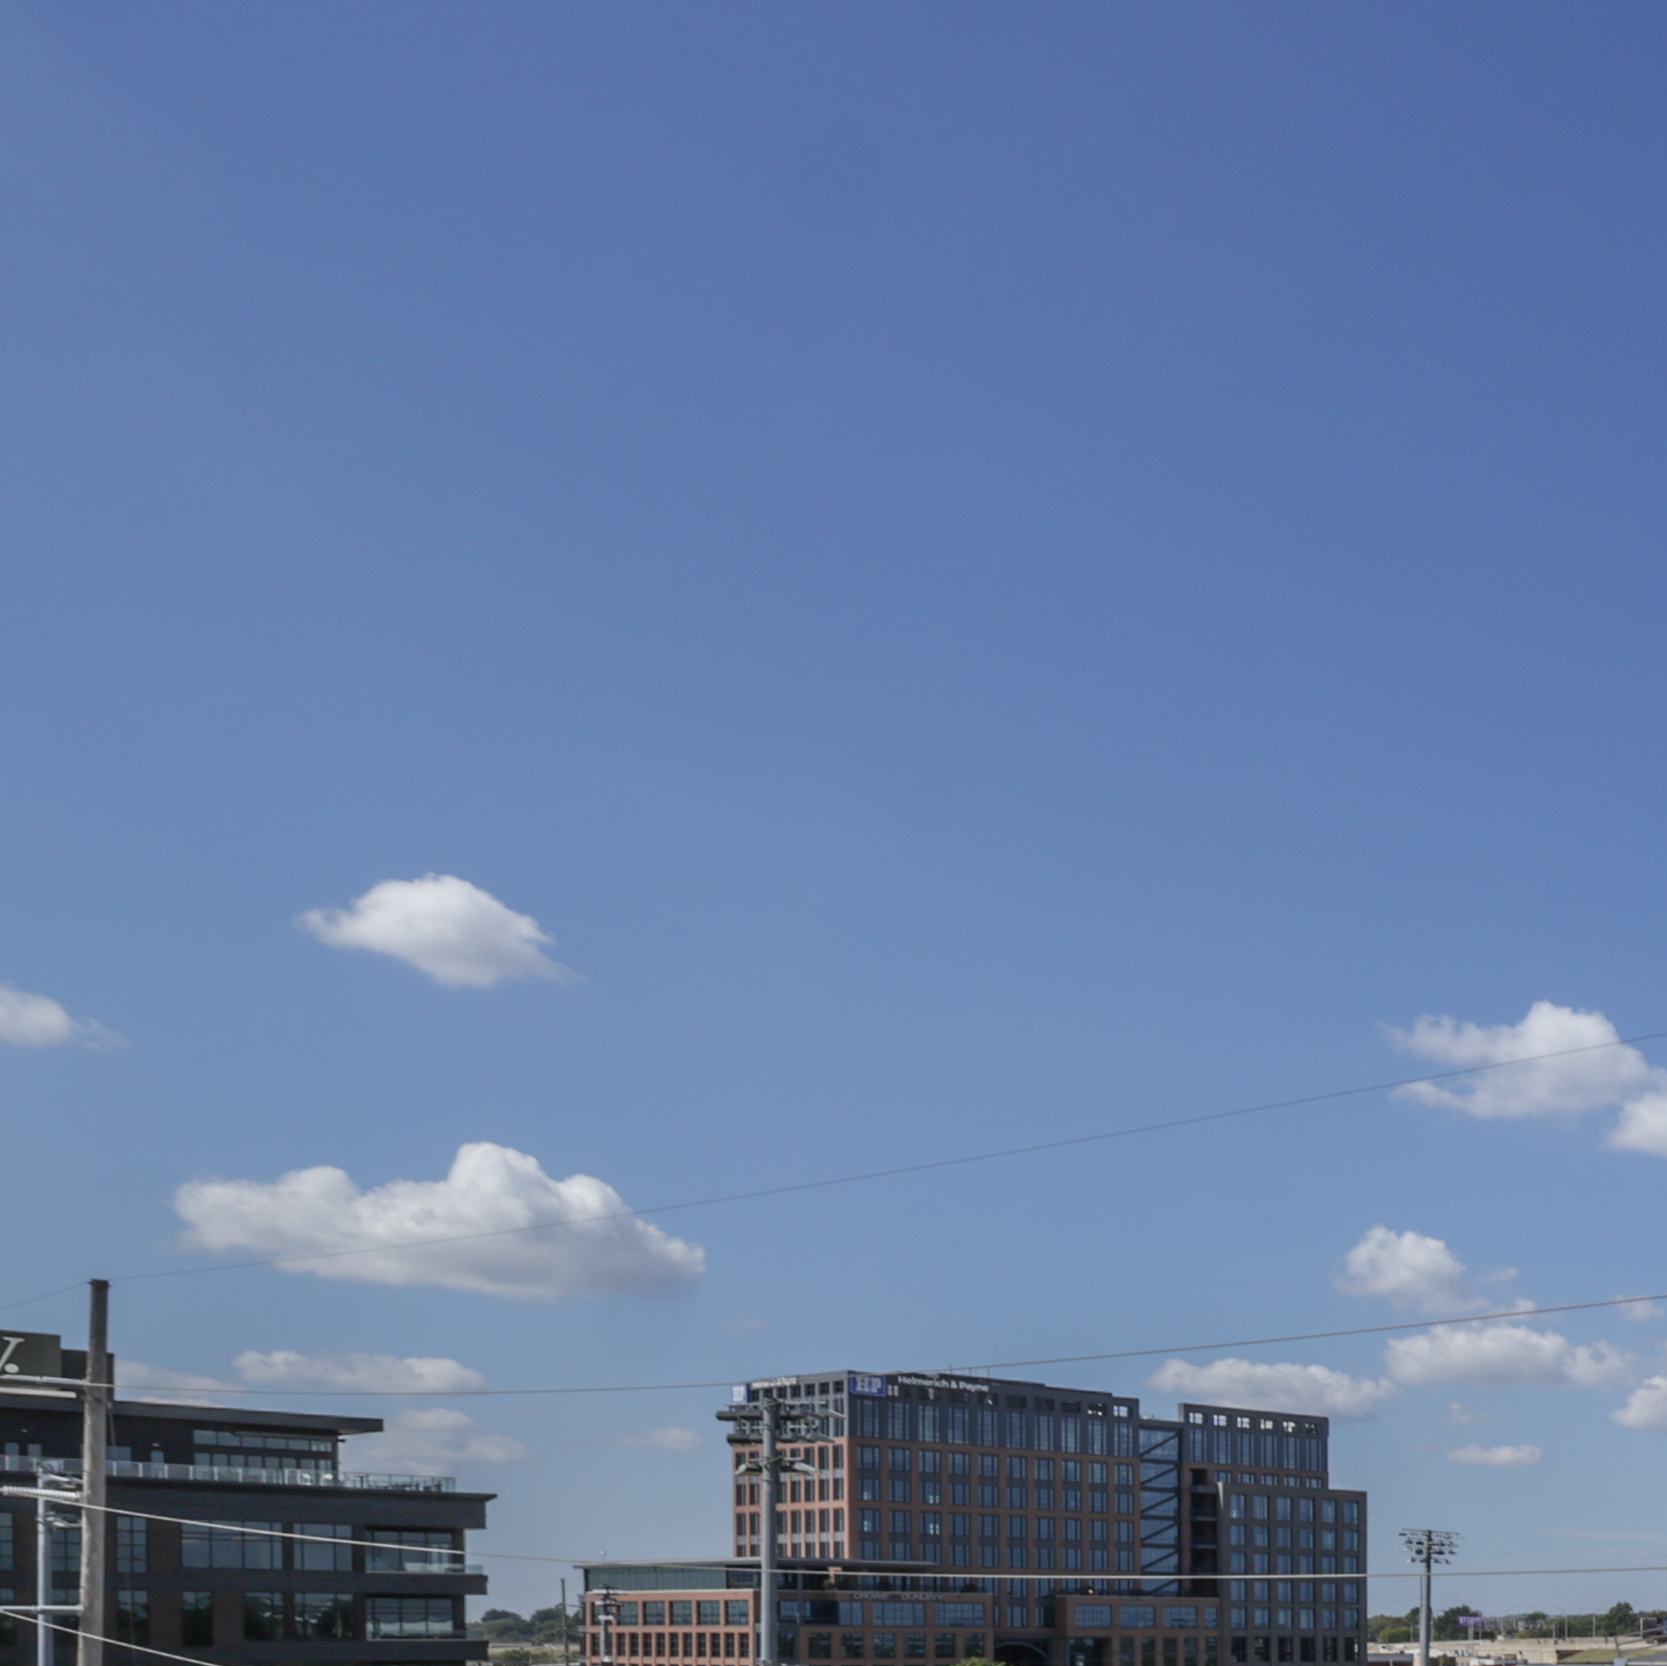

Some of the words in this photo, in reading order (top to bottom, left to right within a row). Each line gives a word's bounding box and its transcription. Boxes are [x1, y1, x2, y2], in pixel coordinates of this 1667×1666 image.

[897, 1375, 950, 1389] Helmerich
[950, 1380, 958, 1389] &
[959, 1380, 990, 1392] Payne
